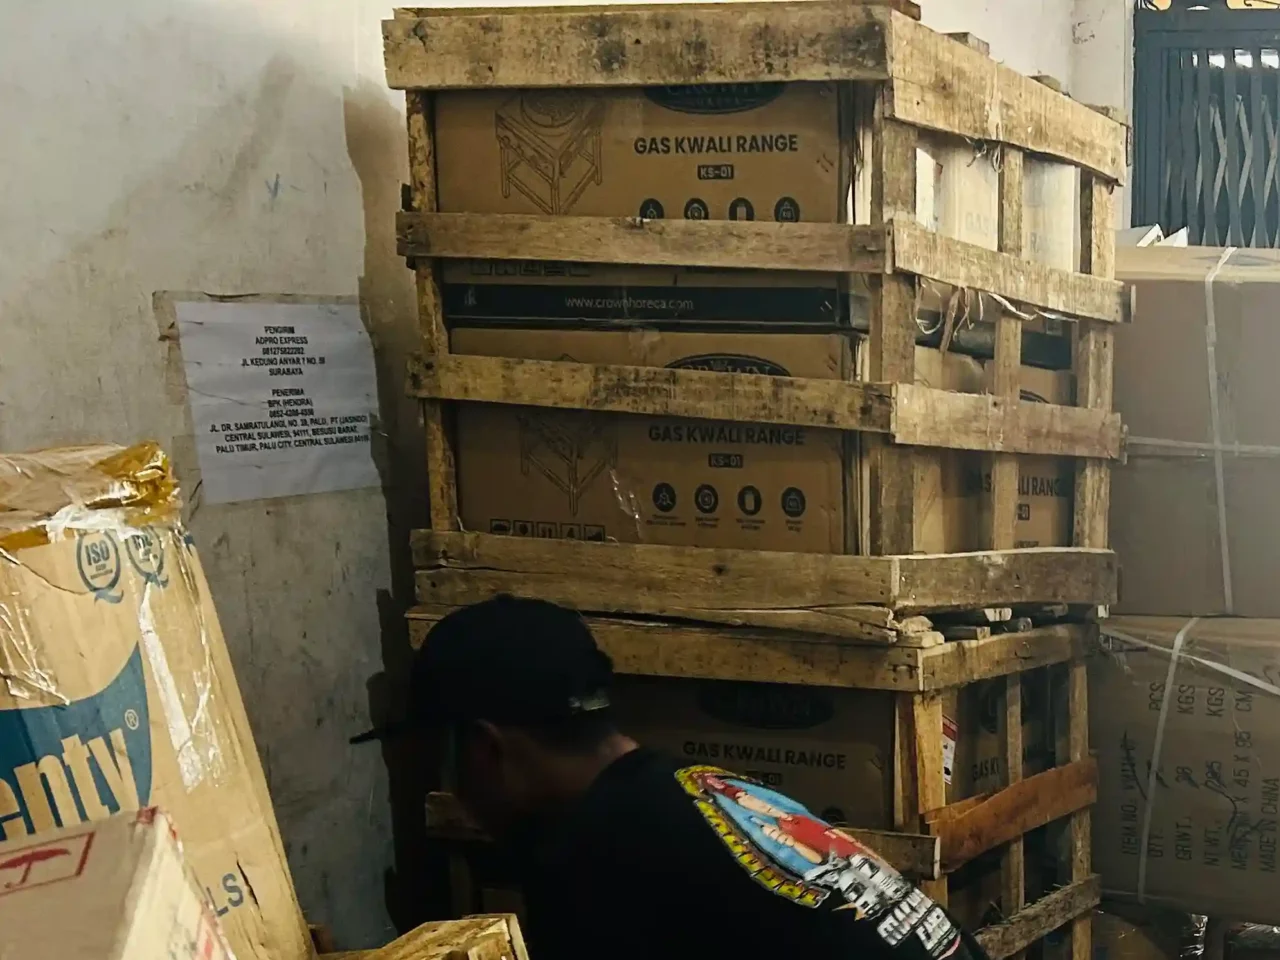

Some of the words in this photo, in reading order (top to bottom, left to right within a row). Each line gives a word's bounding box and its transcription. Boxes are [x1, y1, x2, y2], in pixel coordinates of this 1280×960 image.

[634, 136, 671, 155] GAS
[675, 135, 732, 154] KWALI
[736, 133, 799, 153] RANGE
[699, 166, 733, 179] KS-01
[279, 336, 308, 345] EXPRESS
[268, 368, 303, 376] SURABAYA
[215, 445, 235, 454] PALU
[259, 441, 276, 451] PALU
[294, 437, 323, 448] CENTRAL
[224, 433, 256, 443] CENTRAL
[649, 425, 682, 443] GAS
[686, 426, 740, 444] KWALI
[743, 428, 805, 446] RANGE
[84, 539, 111, 566] ISO
[1177, 684, 1196, 715] KGS
[1205, 687, 1225, 717] KGS
[683, 741, 719, 758] GAS
[723, 744, 781, 763] KWALI
[785, 749, 847, 770] RANGE
[1233, 769, 1251, 788] 45
[1260, 777, 1280, 815] CHINA
[1260, 836, 1277, 873] MADE
